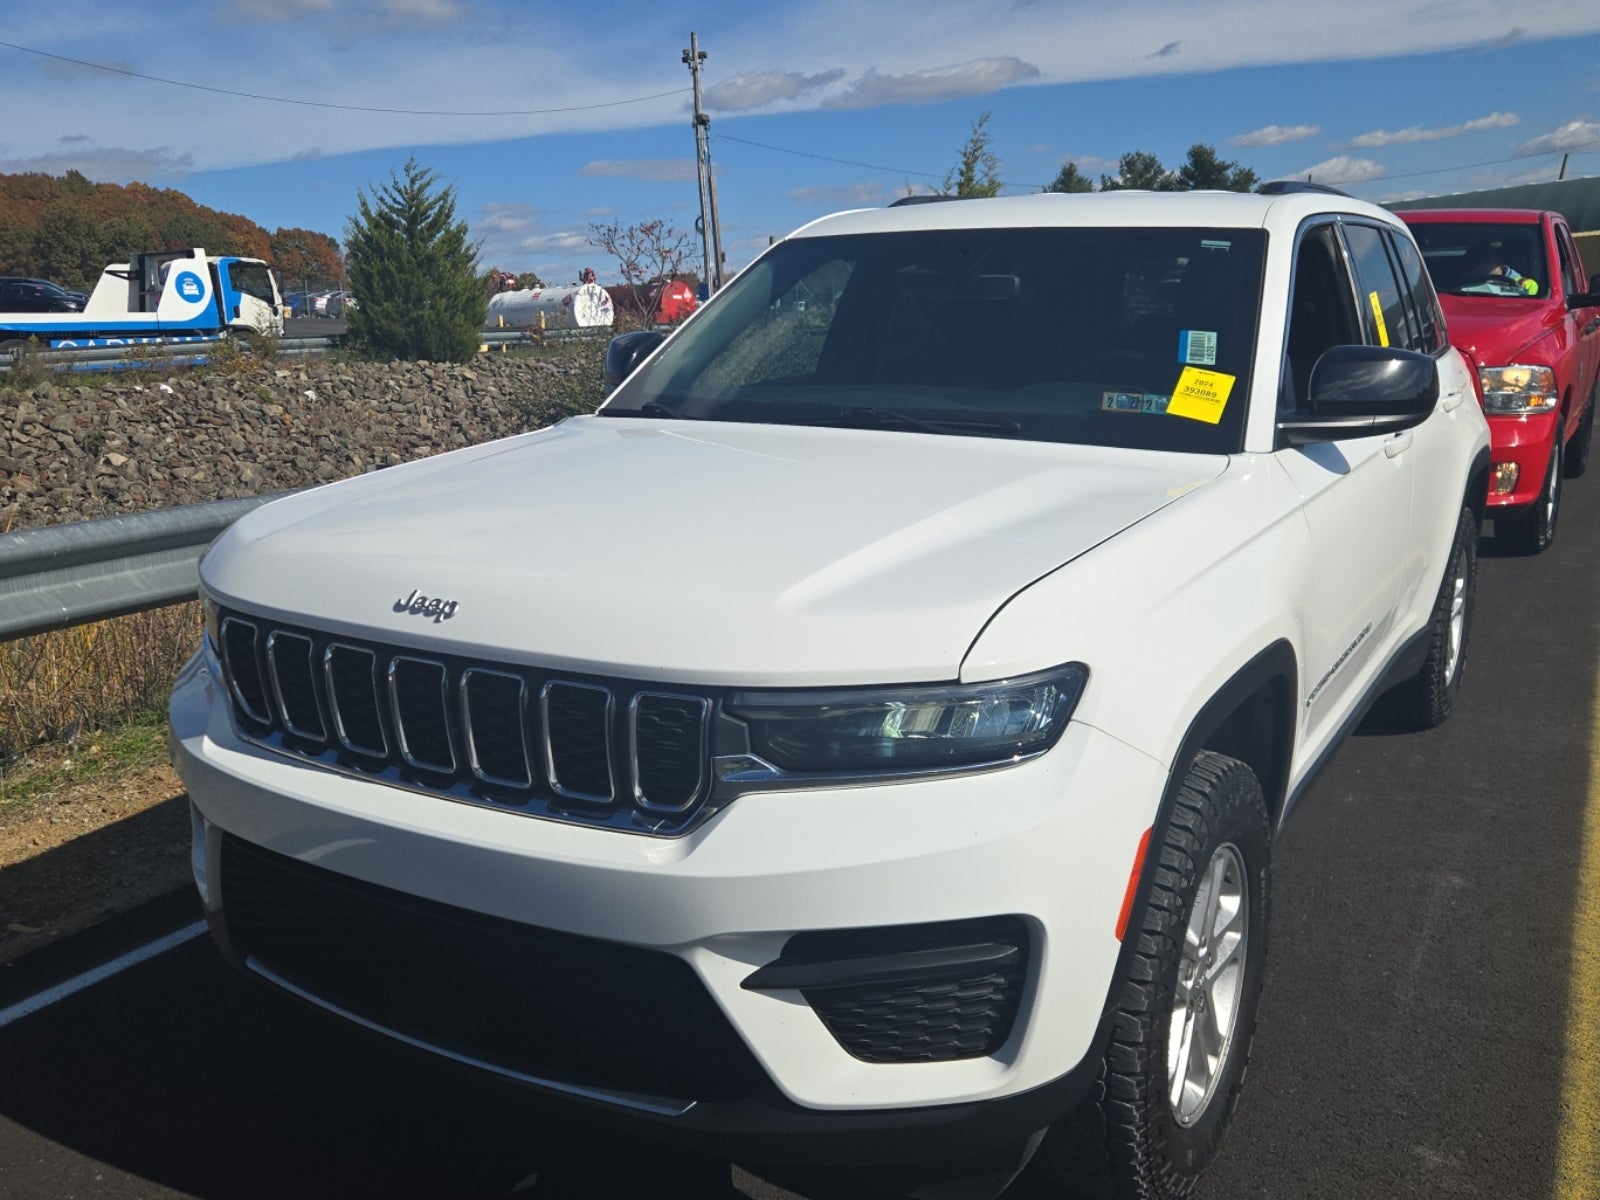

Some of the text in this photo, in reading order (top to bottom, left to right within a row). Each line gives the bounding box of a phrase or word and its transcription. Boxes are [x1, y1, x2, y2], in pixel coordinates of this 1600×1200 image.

[1194, 378, 1214, 388] 2024
[1183, 385, 1217, 398] 393089
[392, 588, 460, 624] Jeep
